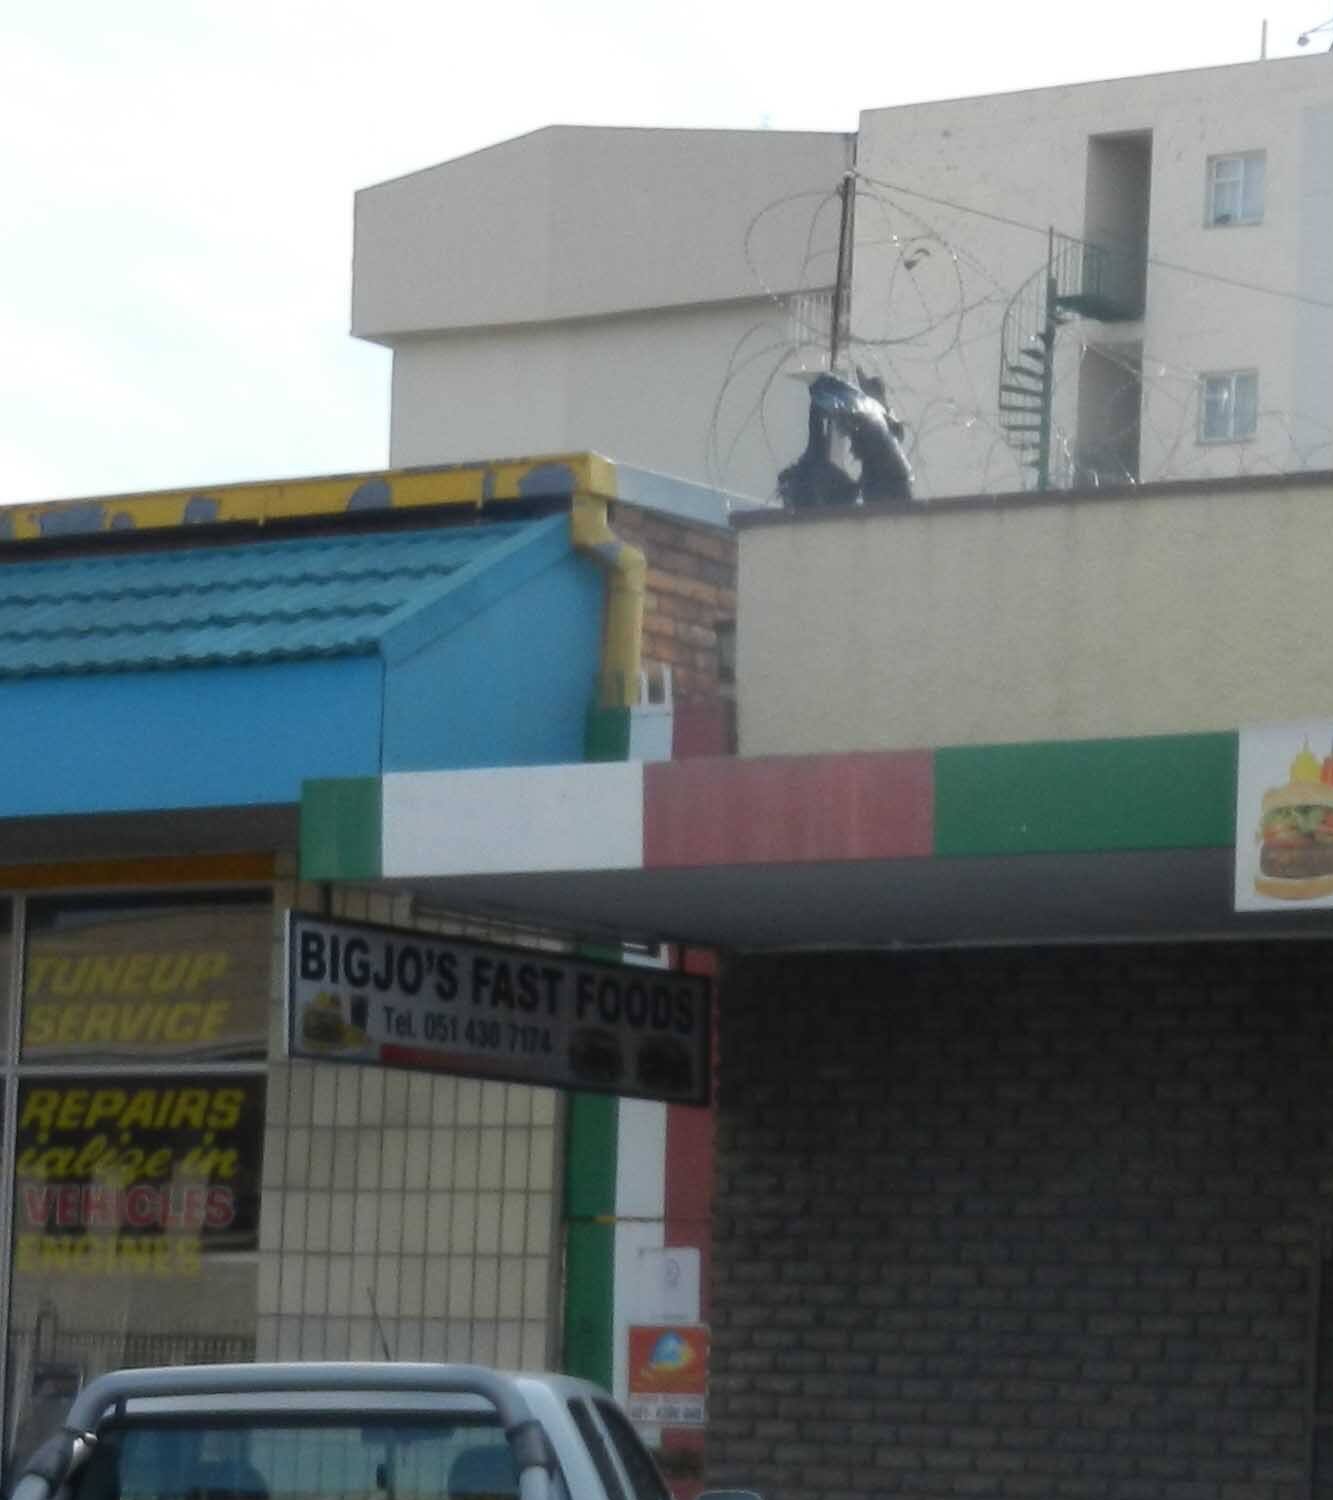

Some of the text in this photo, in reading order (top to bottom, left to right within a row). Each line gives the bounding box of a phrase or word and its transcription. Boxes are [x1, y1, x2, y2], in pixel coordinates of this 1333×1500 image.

[299, 929, 696, 1035] BIGJO'S FAST FOODS
[24, 999, 232, 1044] SERVICE
[424, 1010, 457, 1042] 051
[20, 1088, 244, 1144] REPAIRS
[178, 1132, 239, 1180] in
[22, 1183, 236, 1229] VEHICLES
